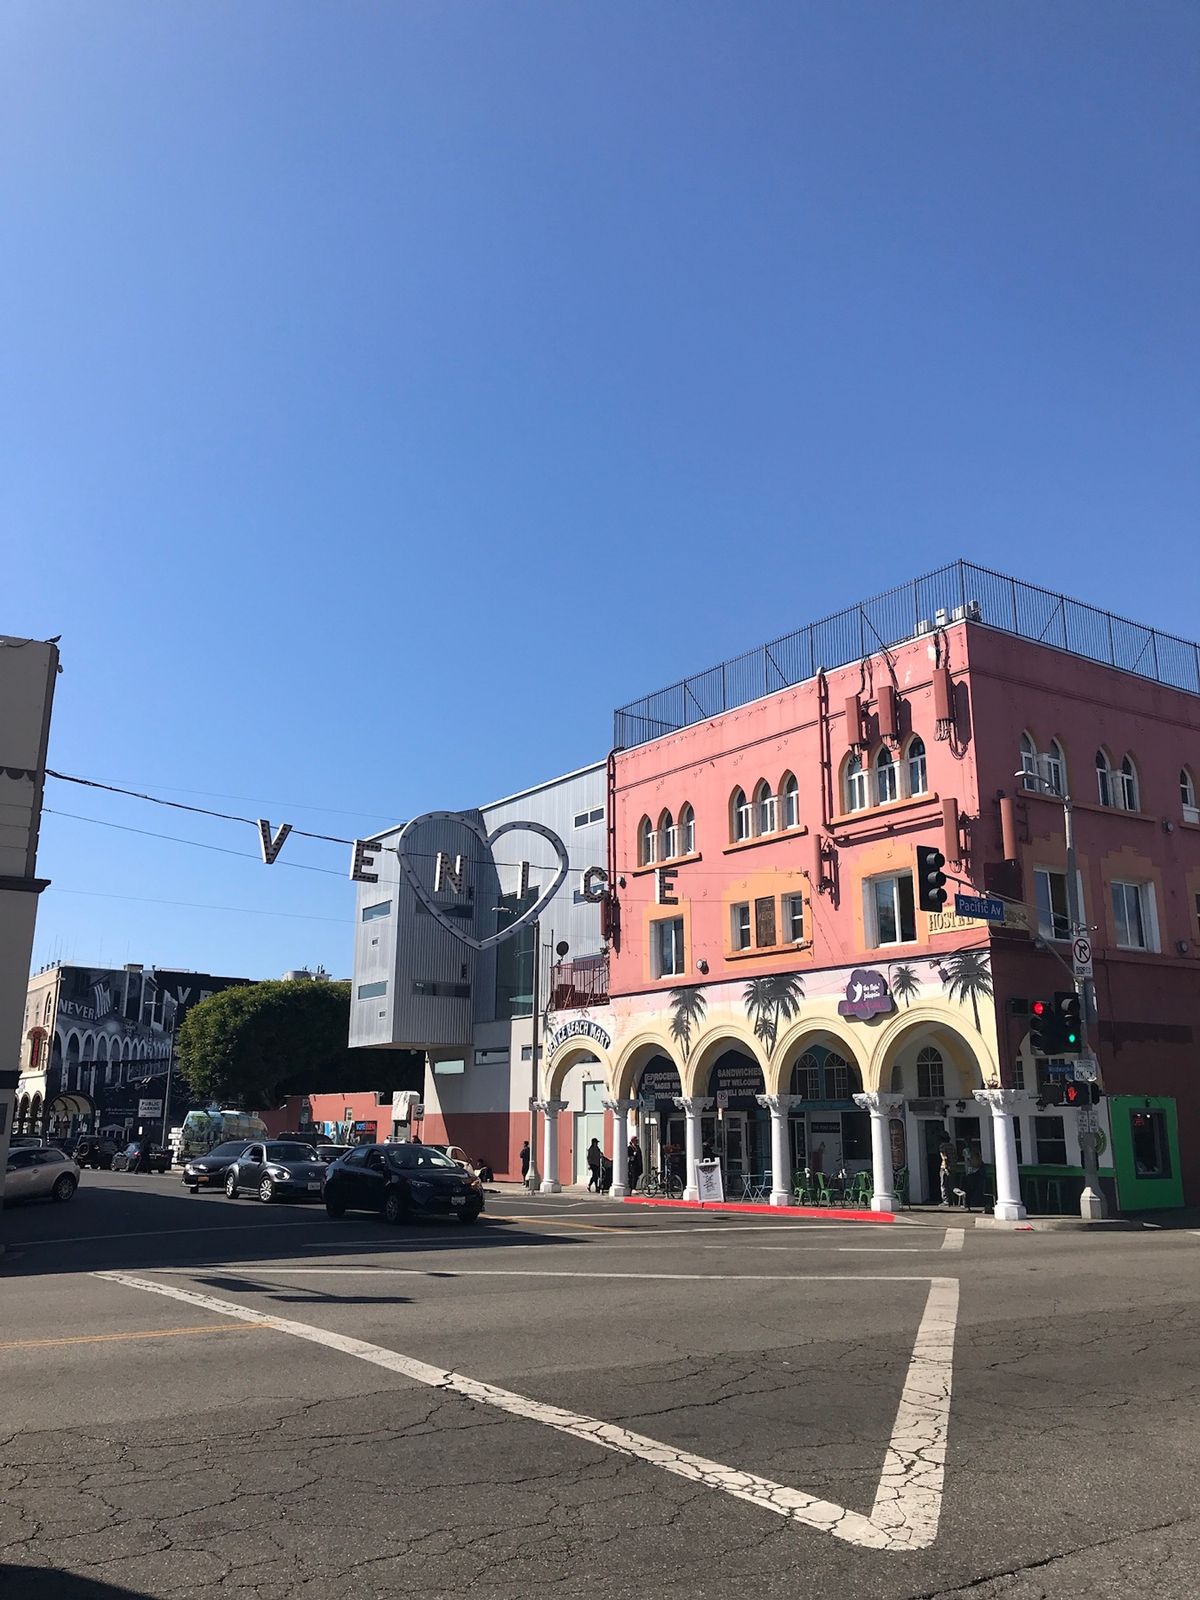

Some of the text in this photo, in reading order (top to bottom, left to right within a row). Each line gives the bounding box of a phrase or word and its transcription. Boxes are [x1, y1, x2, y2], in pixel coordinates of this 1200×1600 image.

[257, 819, 678, 905] VENICE
[959, 900, 1001, 916] Pacific Av
[547, 1021, 610, 1056] VENICE BEACH MART
[717, 1067, 762, 1078] SANDWICHES
[727, 1088, 737, 1097] ELI
